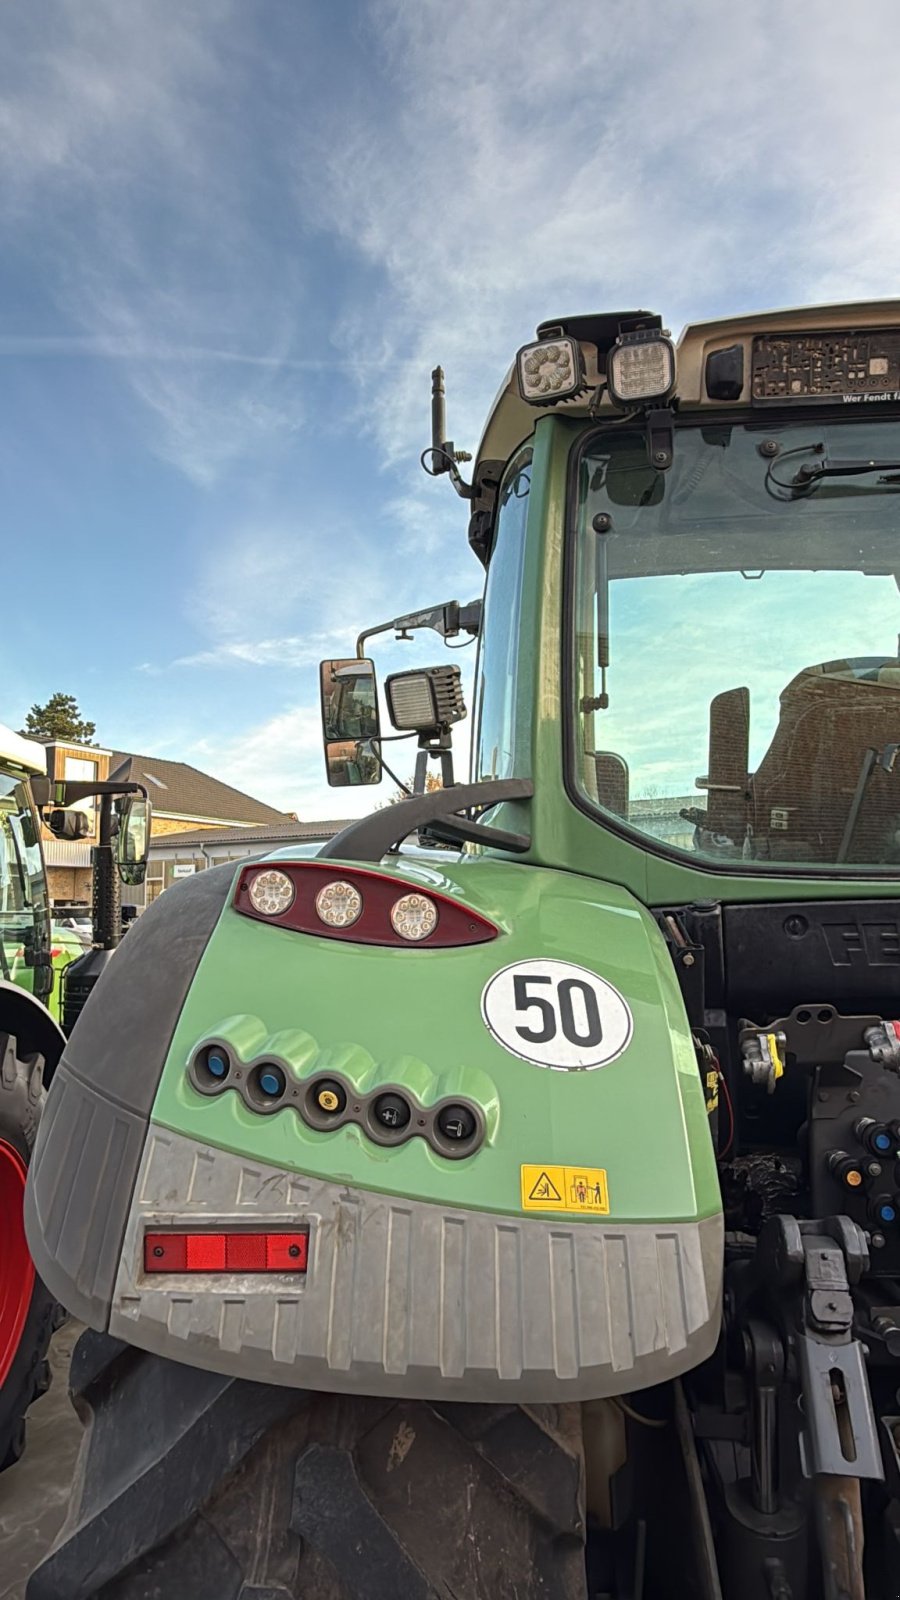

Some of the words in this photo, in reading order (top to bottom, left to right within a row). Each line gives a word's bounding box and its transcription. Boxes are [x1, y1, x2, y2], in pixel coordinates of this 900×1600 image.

[843, 395, 862, 403] Wer
[863, 392, 891, 402] Fendt
[513, 974, 603, 1048] 50
